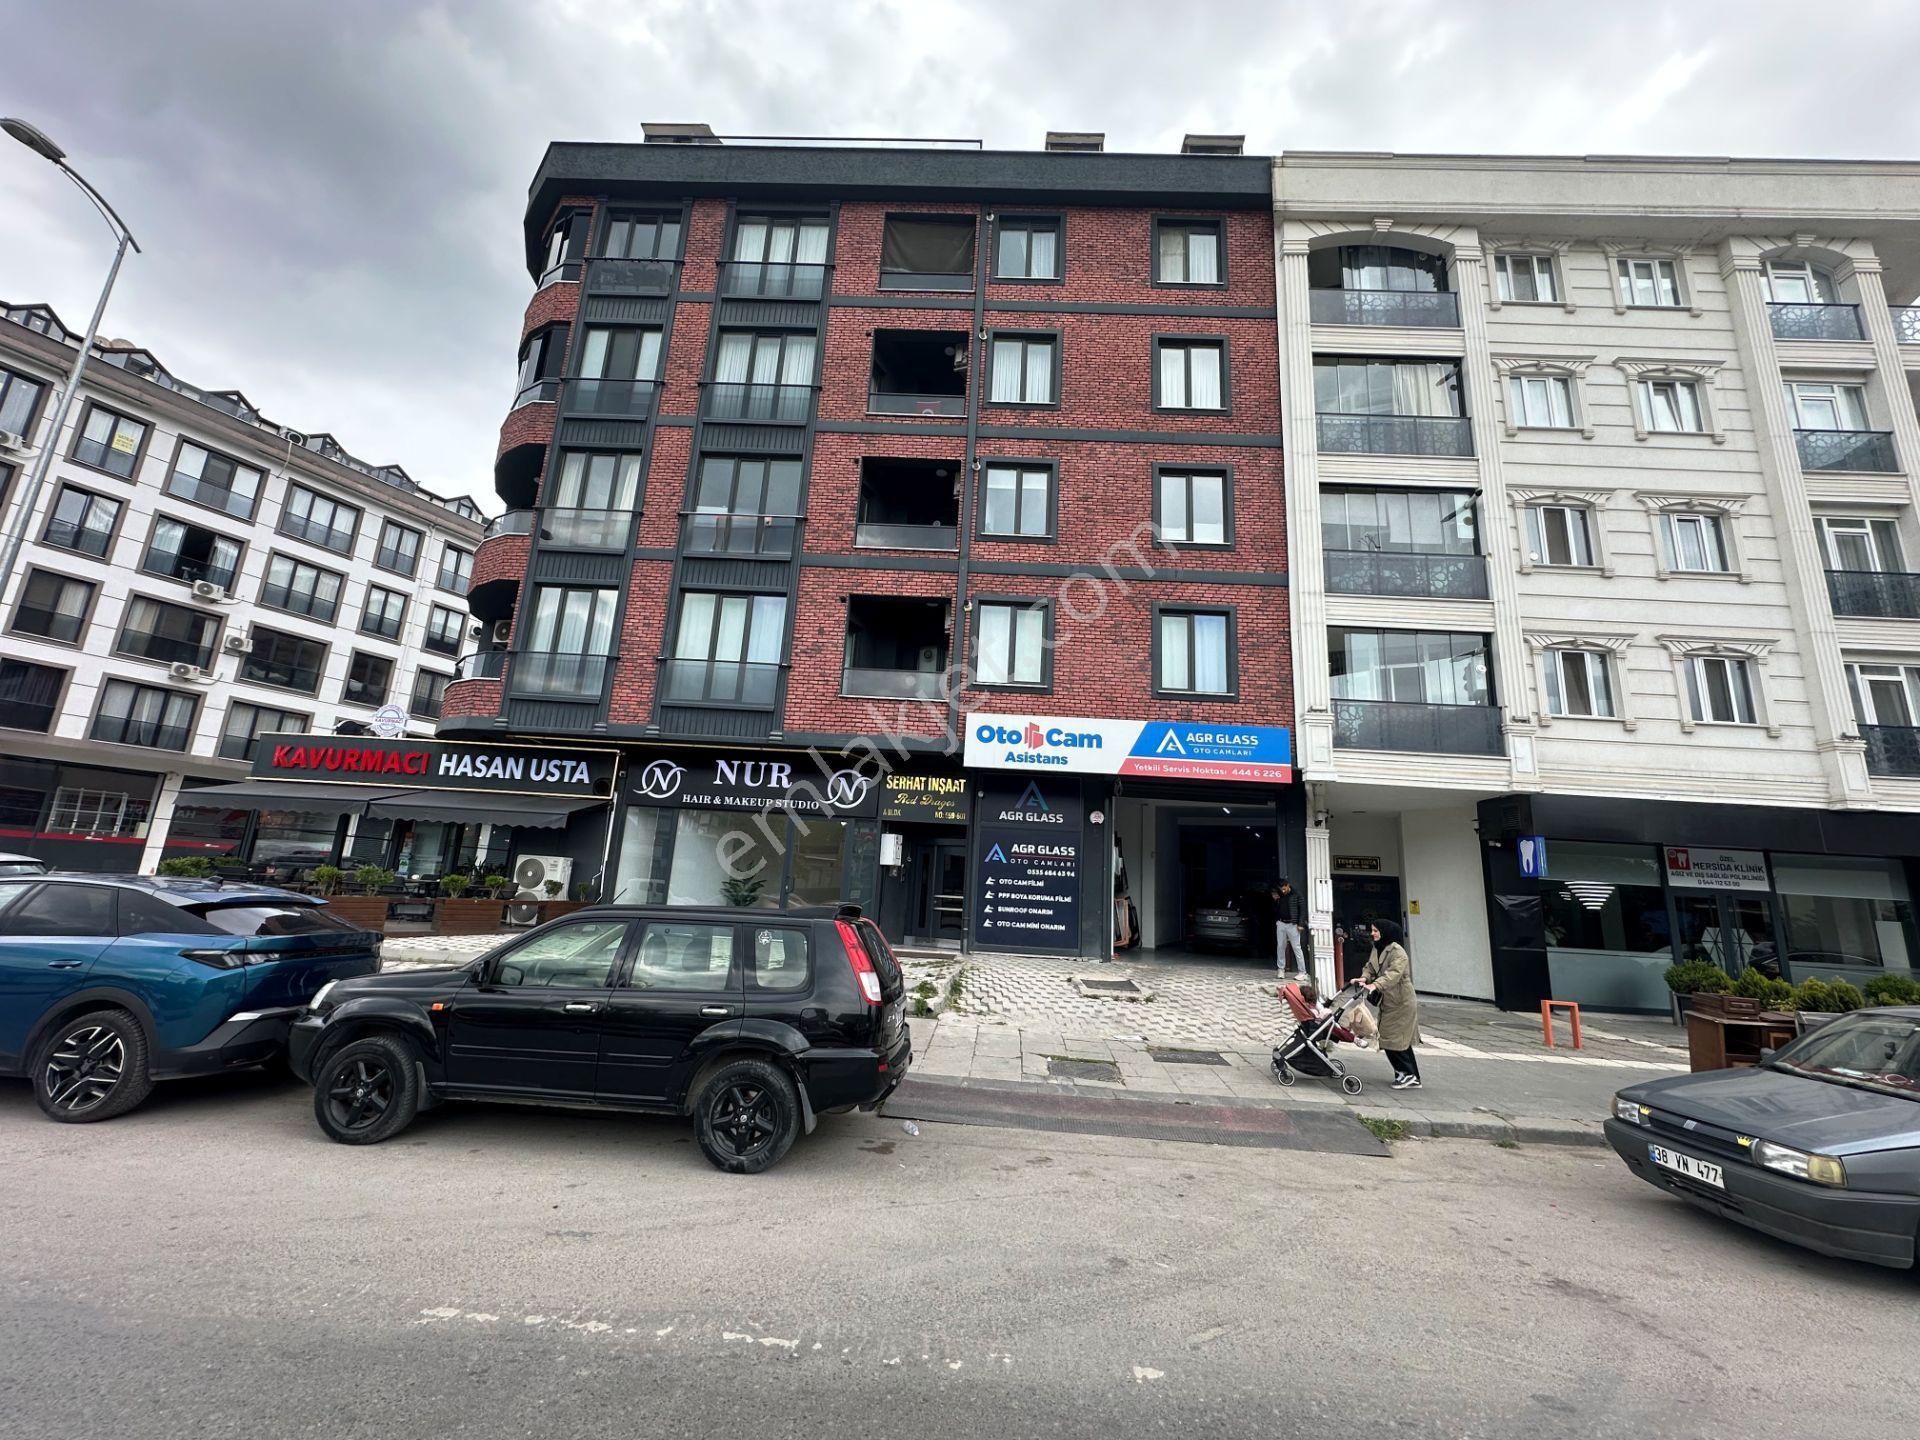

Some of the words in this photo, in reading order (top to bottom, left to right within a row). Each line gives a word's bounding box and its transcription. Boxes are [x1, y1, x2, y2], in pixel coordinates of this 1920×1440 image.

[976, 725, 1022, 744] Oto
[1046, 728, 1103, 749] Cam
[1186, 732, 1213, 743] AGR
[1216, 733, 1259, 746] GLASS
[272, 745, 431, 775] KAVURMACI
[438, 753, 525, 779] HASAN
[530, 758, 590, 783] USTA
[1005, 752, 1068, 765] Asistans
[713, 759, 793, 788] NUR
[1134, 763, 1161, 772] Yetkili
[1163, 765, 1190, 774] Servis
[1192, 767, 1227, 776] Noktası
[1231, 768, 1251, 776] 444
[1254, 769, 1261, 777] 6
[1263, 770, 1282, 778] 226
[886, 774, 926, 791] SERHAT
[928, 776, 966, 794] İNŞAAT
[682, 794, 711, 804] HAIR
[713, 795, 721, 805] &
[723, 796, 774, 807] MAKEUP
[775, 799, 820, 810] STUDIO
[999, 811, 1023, 821] AGR
[1026, 812, 1064, 823] GLASS
[1011, 844, 1035, 854] AGR
[1037, 845, 1075, 856] GLASS
[1034, 859, 1075, 867] CAMLARI
[1692, 861, 1733, 872] MERSİDA
[1734, 863, 1765, 873] KLİNİK
[1028, 894, 1054, 902] KORUMA
[1011, 921, 1026, 929] CAM
[1040, 923, 1066, 931] ONARIM
[1655, 1147, 1668, 1164] 38
[1675, 1153, 1689, 1172] VN
[1697, 1162, 1718, 1183] 477
